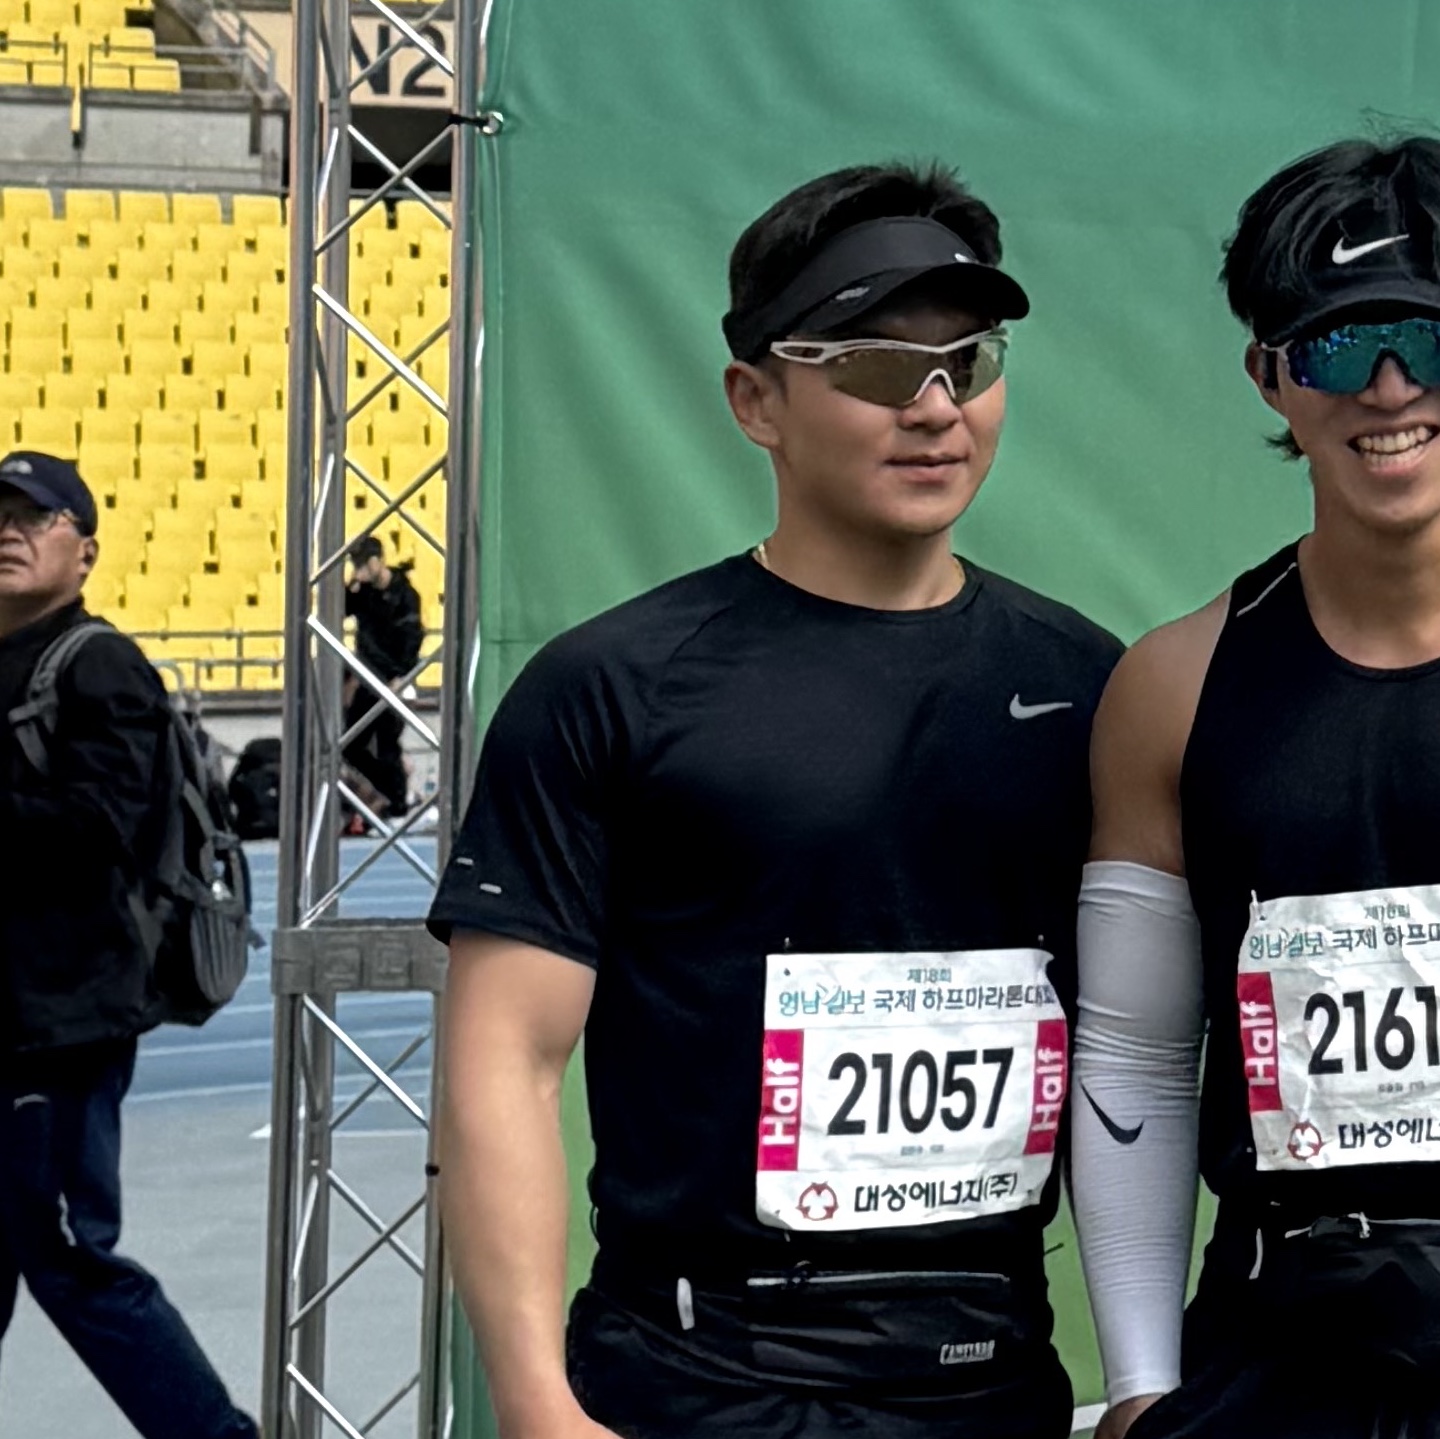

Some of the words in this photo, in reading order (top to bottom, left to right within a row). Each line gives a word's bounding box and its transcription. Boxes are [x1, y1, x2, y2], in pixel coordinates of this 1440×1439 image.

[1333, 926, 1378, 952] 국제
[873, 988, 917, 1013] 국제
[1240, 1001, 1276, 1087] Half
[761, 1057, 800, 1146] Half
[827, 1047, 1014, 1136] 21057
[1031, 1046, 1064, 1132] Half
[854, 1172, 1018, 1213] 대성에너지(주)
